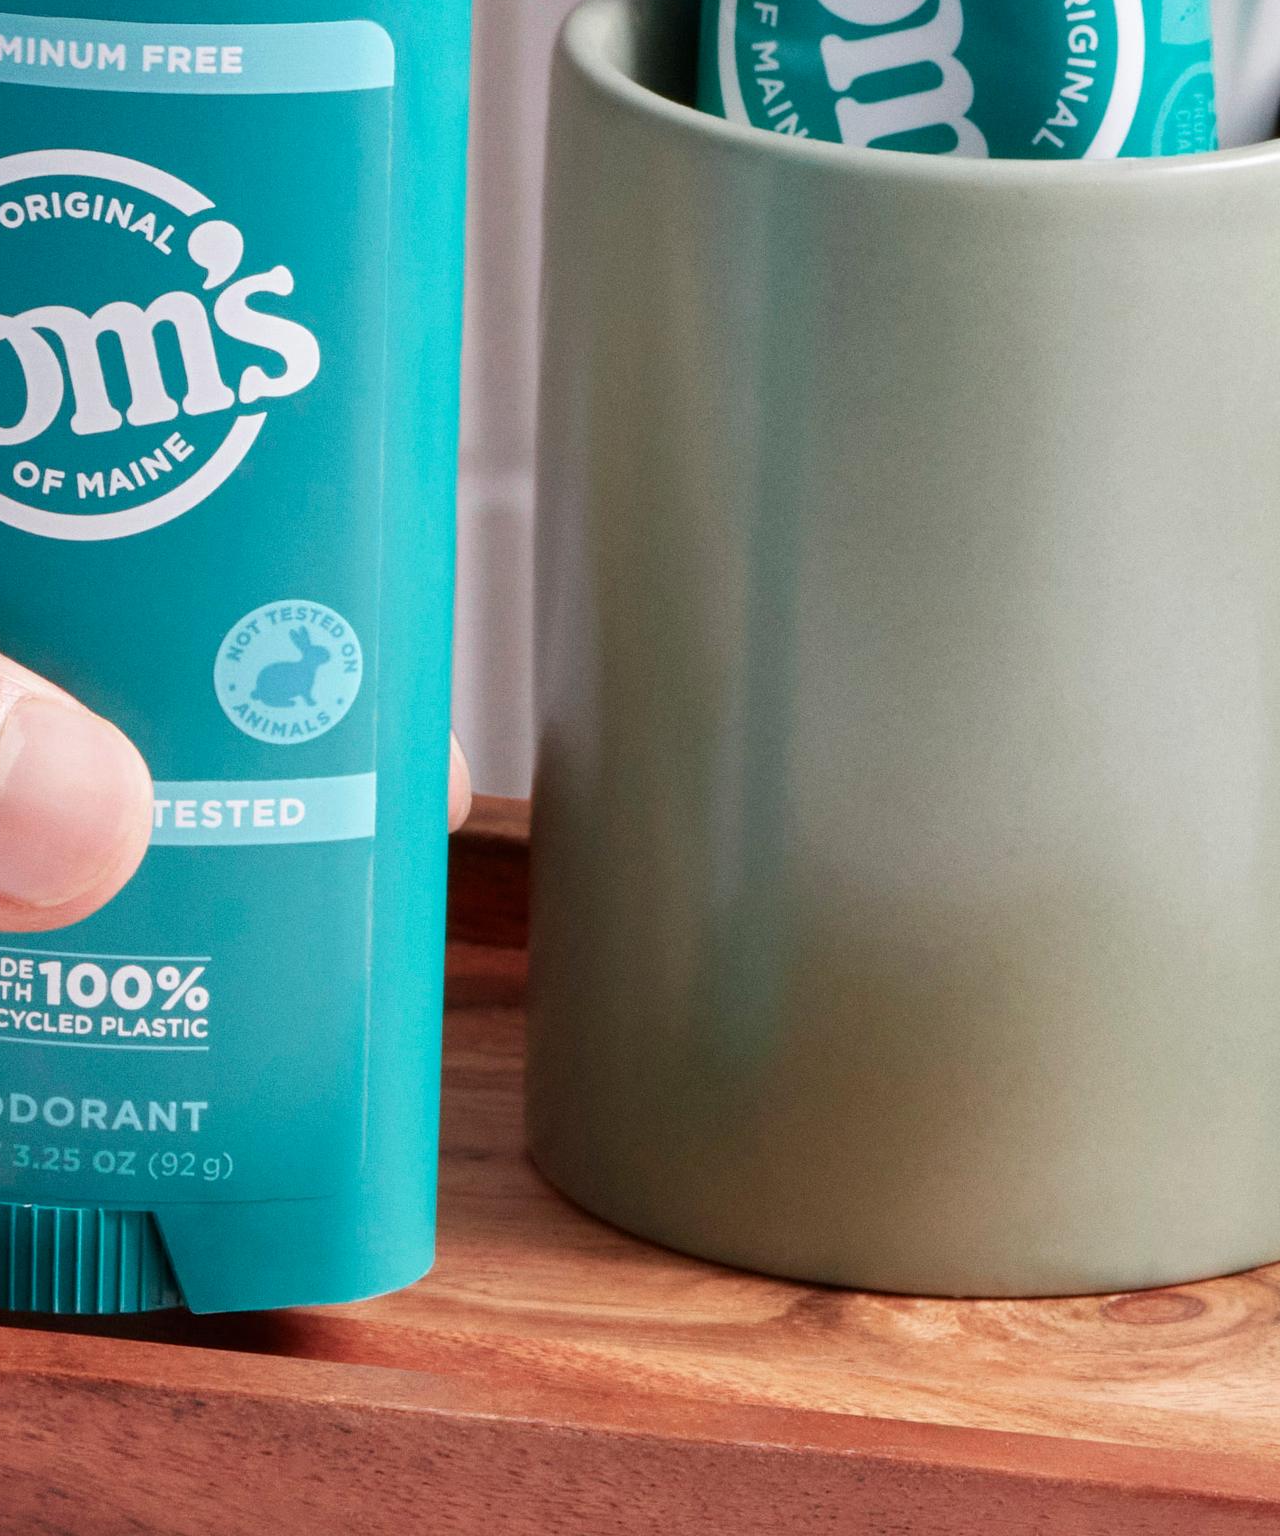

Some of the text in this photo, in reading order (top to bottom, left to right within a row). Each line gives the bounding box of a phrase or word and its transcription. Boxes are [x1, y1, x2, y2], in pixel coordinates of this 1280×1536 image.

[142, 45, 245, 75] FREE
[751, 40, 809, 139] MAIN
[12, 431, 195, 499] OF MAINE
[227, 606, 358, 673] NOT TESTED ON
[232, 703, 331, 737] ANIMALS
[153, 798, 305, 828] TESTED
[38, 961, 210, 1012] 100%
[101, 1016, 208, 1038] PLASTIC
[12, 1143, 81, 1172] 3.25
[92, 1150, 137, 1175] OZ
